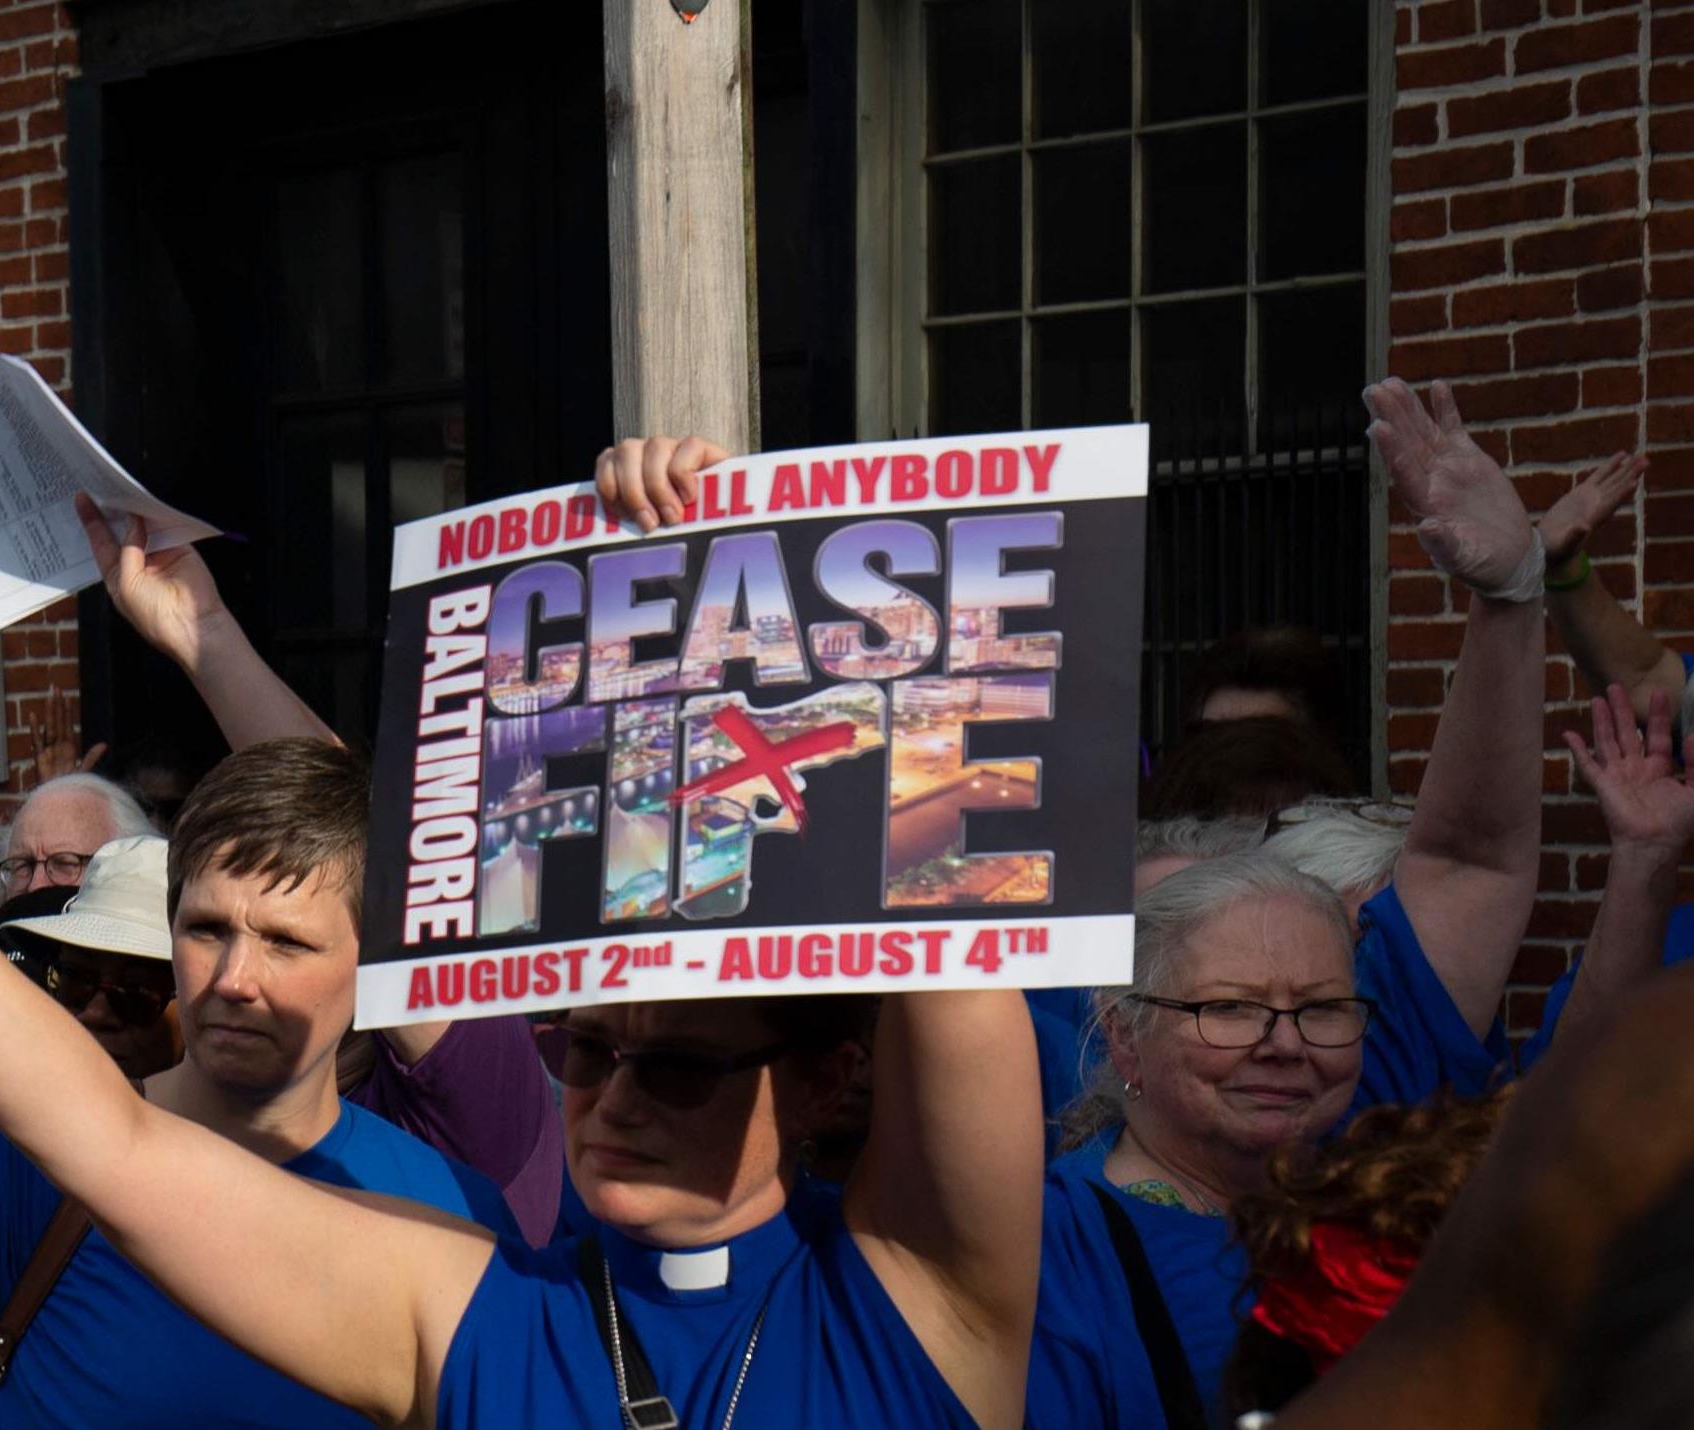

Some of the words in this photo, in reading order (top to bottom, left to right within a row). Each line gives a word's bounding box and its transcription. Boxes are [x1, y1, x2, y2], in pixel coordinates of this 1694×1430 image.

[767, 443, 1063, 513] ANYBODY
[485, 510, 1065, 716] CEASE
[403, 583, 493, 945] BALTIMORE
[407, 947, 590, 1010] AUGUST
[599, 940, 673, 989] 2nd
[717, 929, 951, 982] AUGUST
[964, 926, 1049, 974] 4TH
